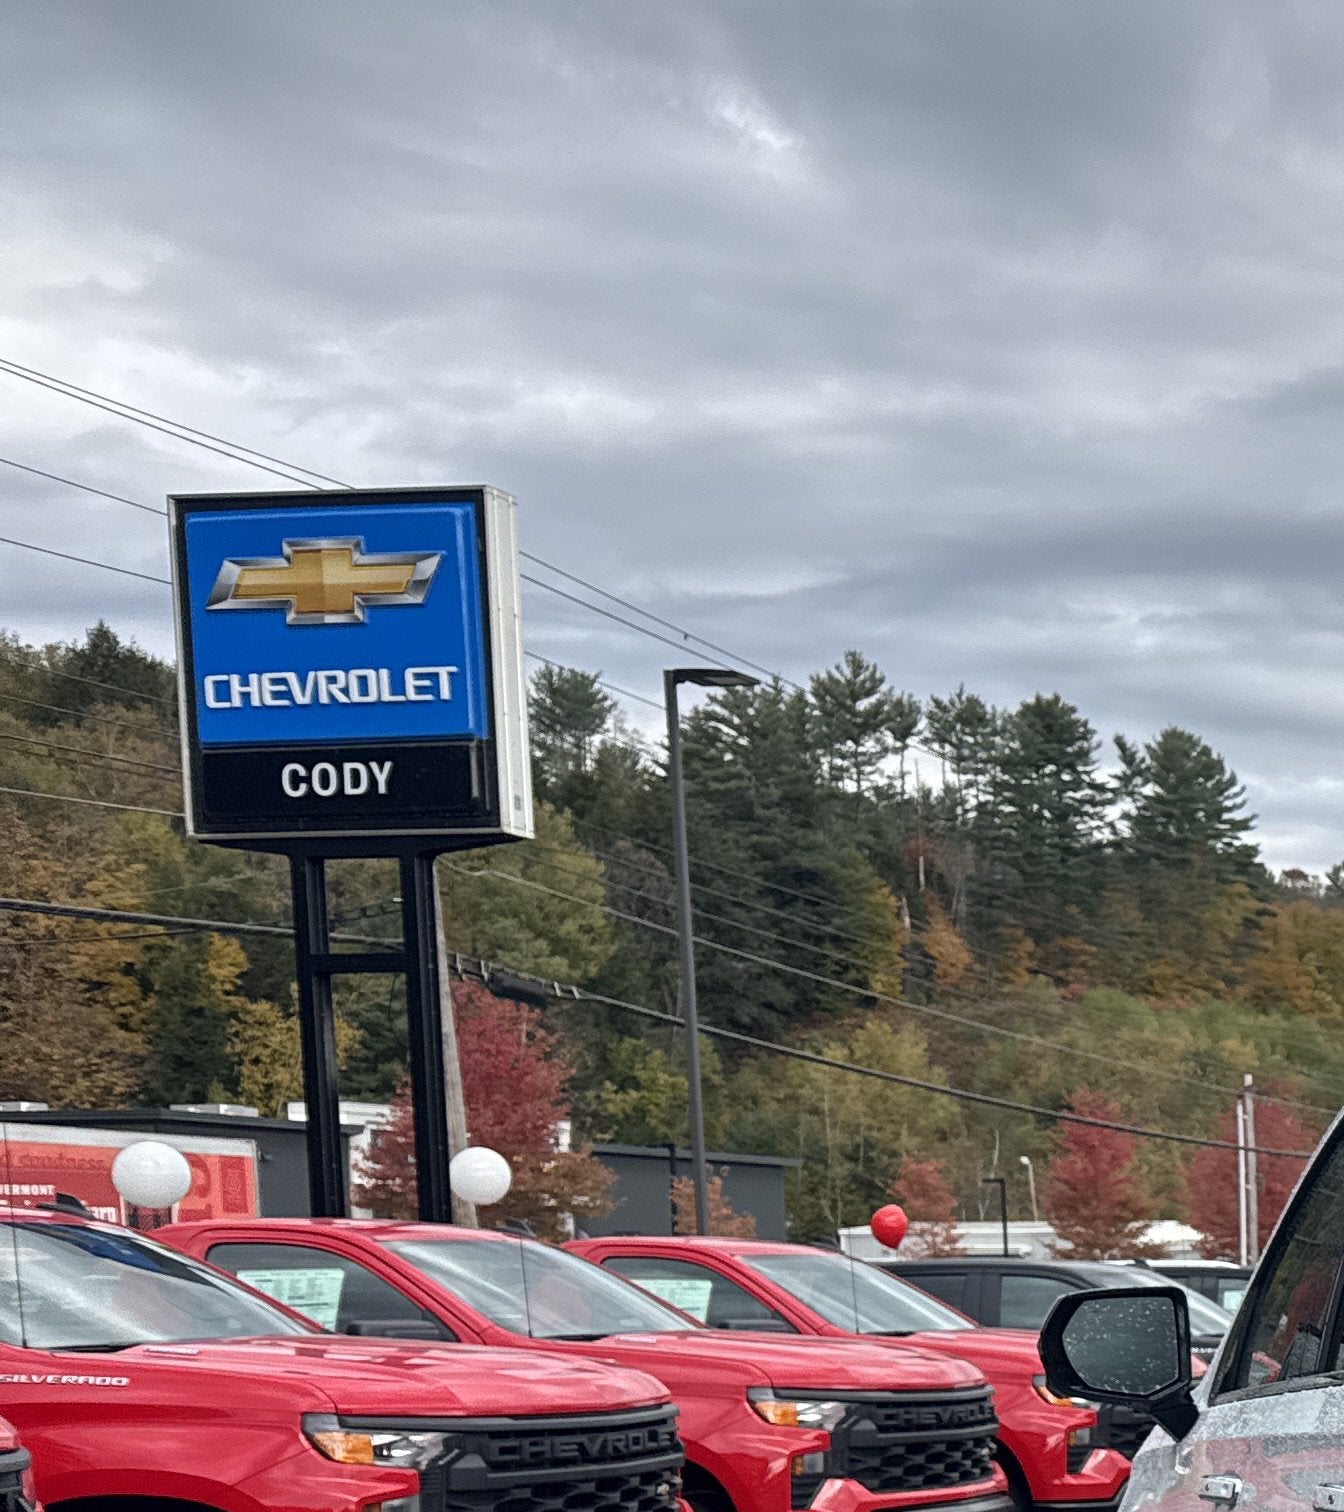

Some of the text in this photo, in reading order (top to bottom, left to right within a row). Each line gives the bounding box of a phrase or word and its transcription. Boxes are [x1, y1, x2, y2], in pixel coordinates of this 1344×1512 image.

[203, 666, 459, 709] CHEVROLET
[281, 761, 393, 798] CODY
[0, 1374, 130, 1386] SILVERADO
[878, 1403, 994, 1425] CHEVROLE
[489, 1428, 676, 1462] CHEVROLE
